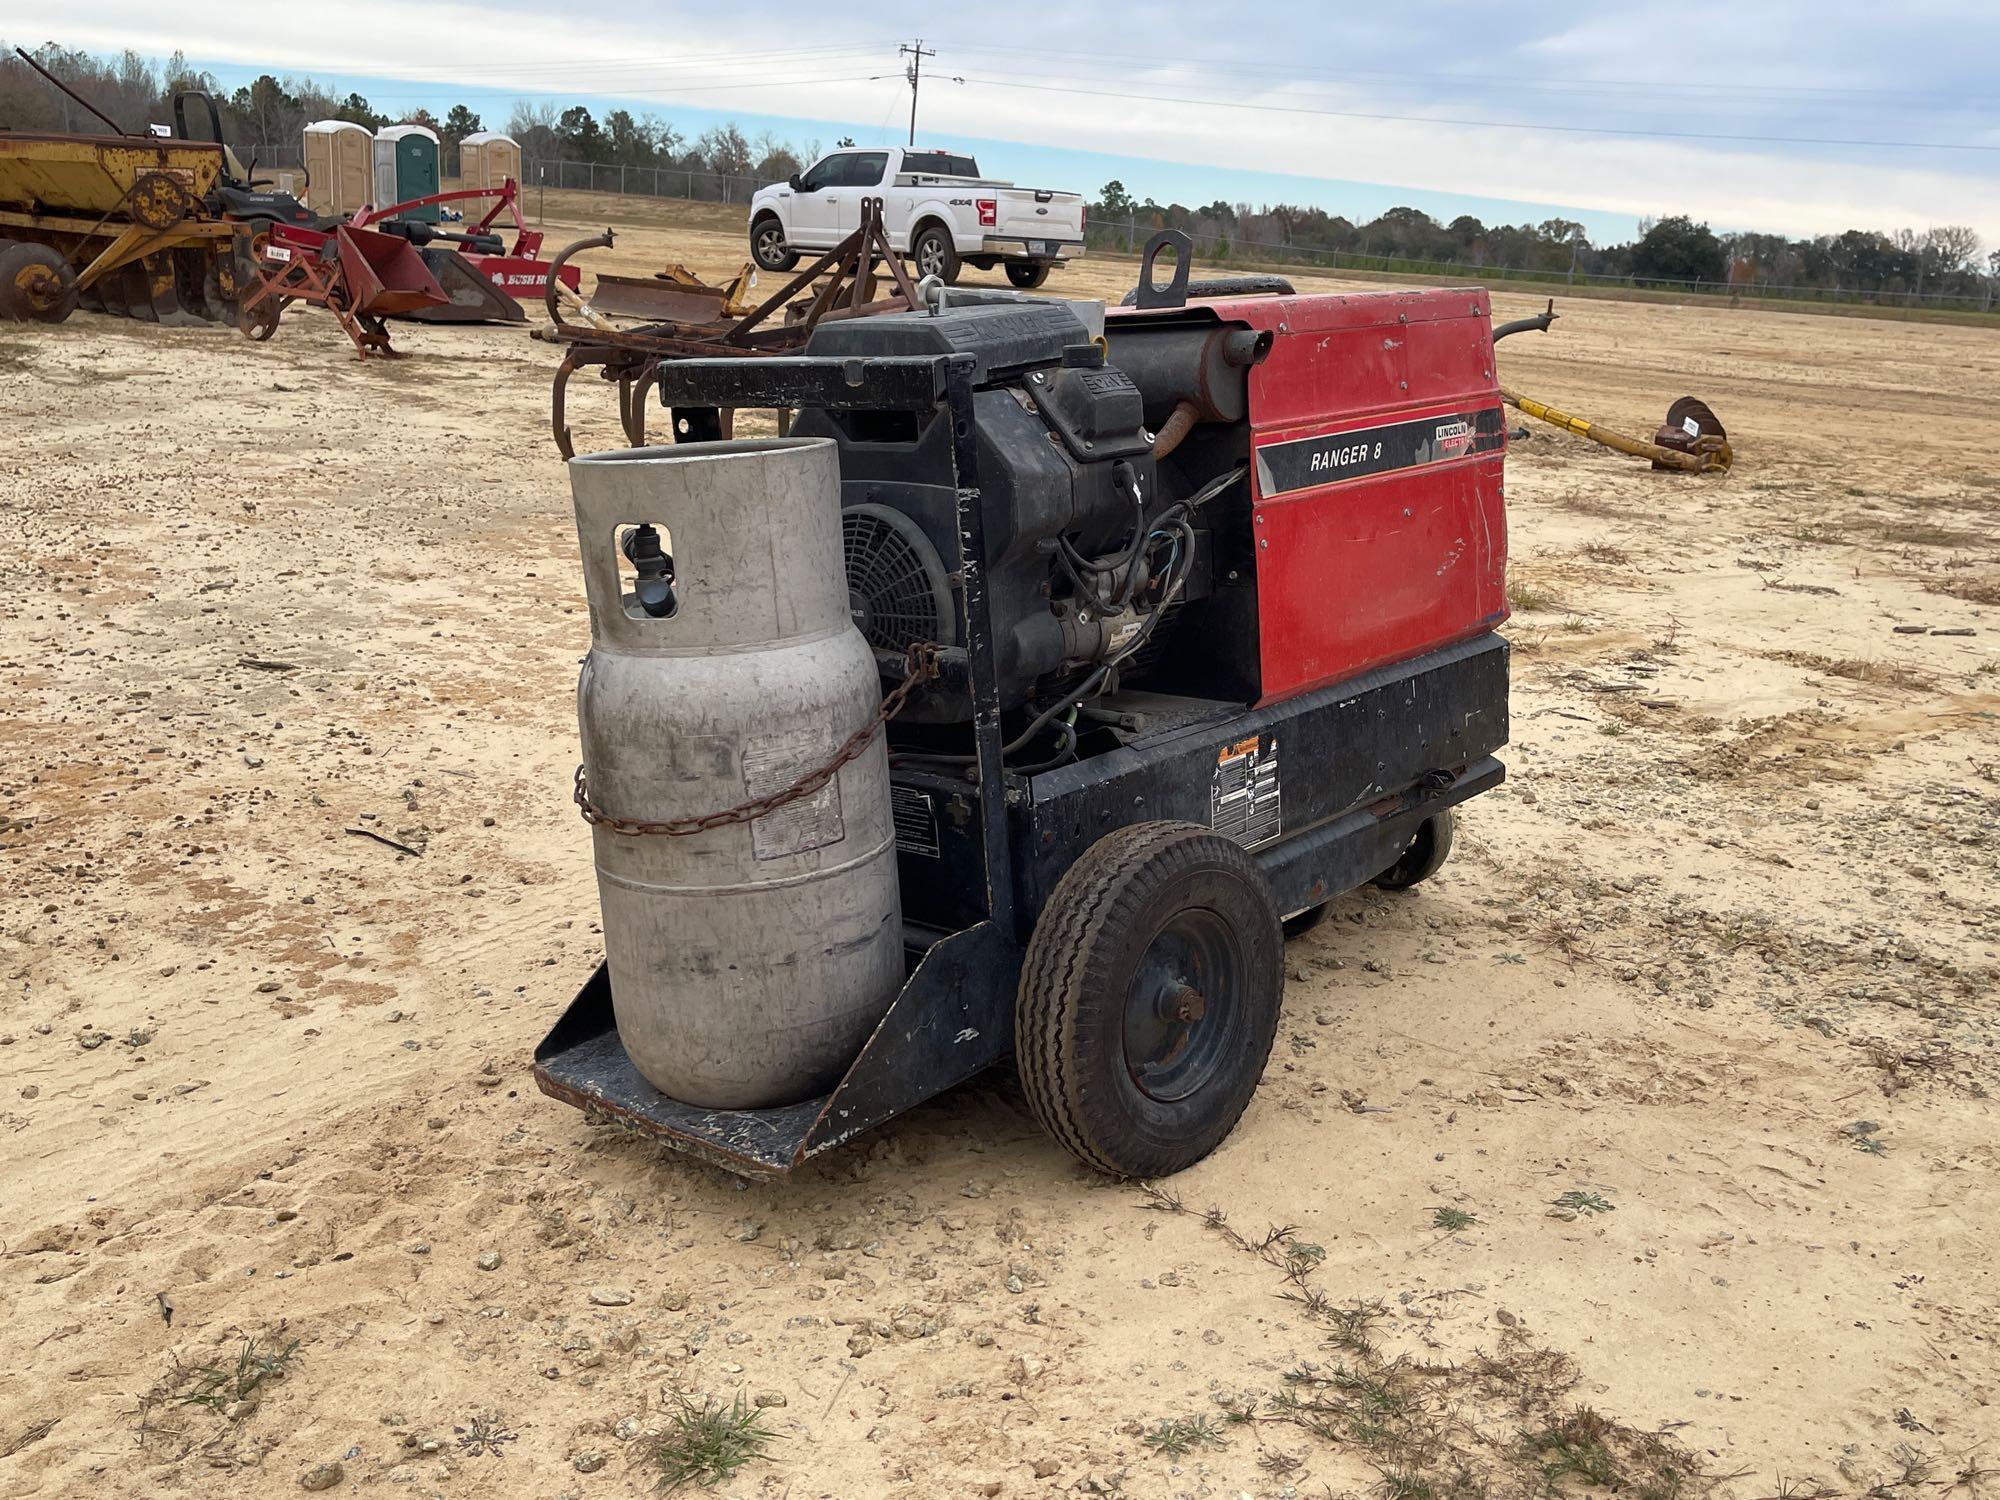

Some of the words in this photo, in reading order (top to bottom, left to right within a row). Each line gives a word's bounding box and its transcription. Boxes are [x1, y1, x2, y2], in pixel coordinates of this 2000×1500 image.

[507, 275, 534, 285] BUSH
[1437, 424, 1466, 438] LINCOLN
[1310, 445, 1368, 471] RANGER
[1373, 442, 1382, 460] 8
